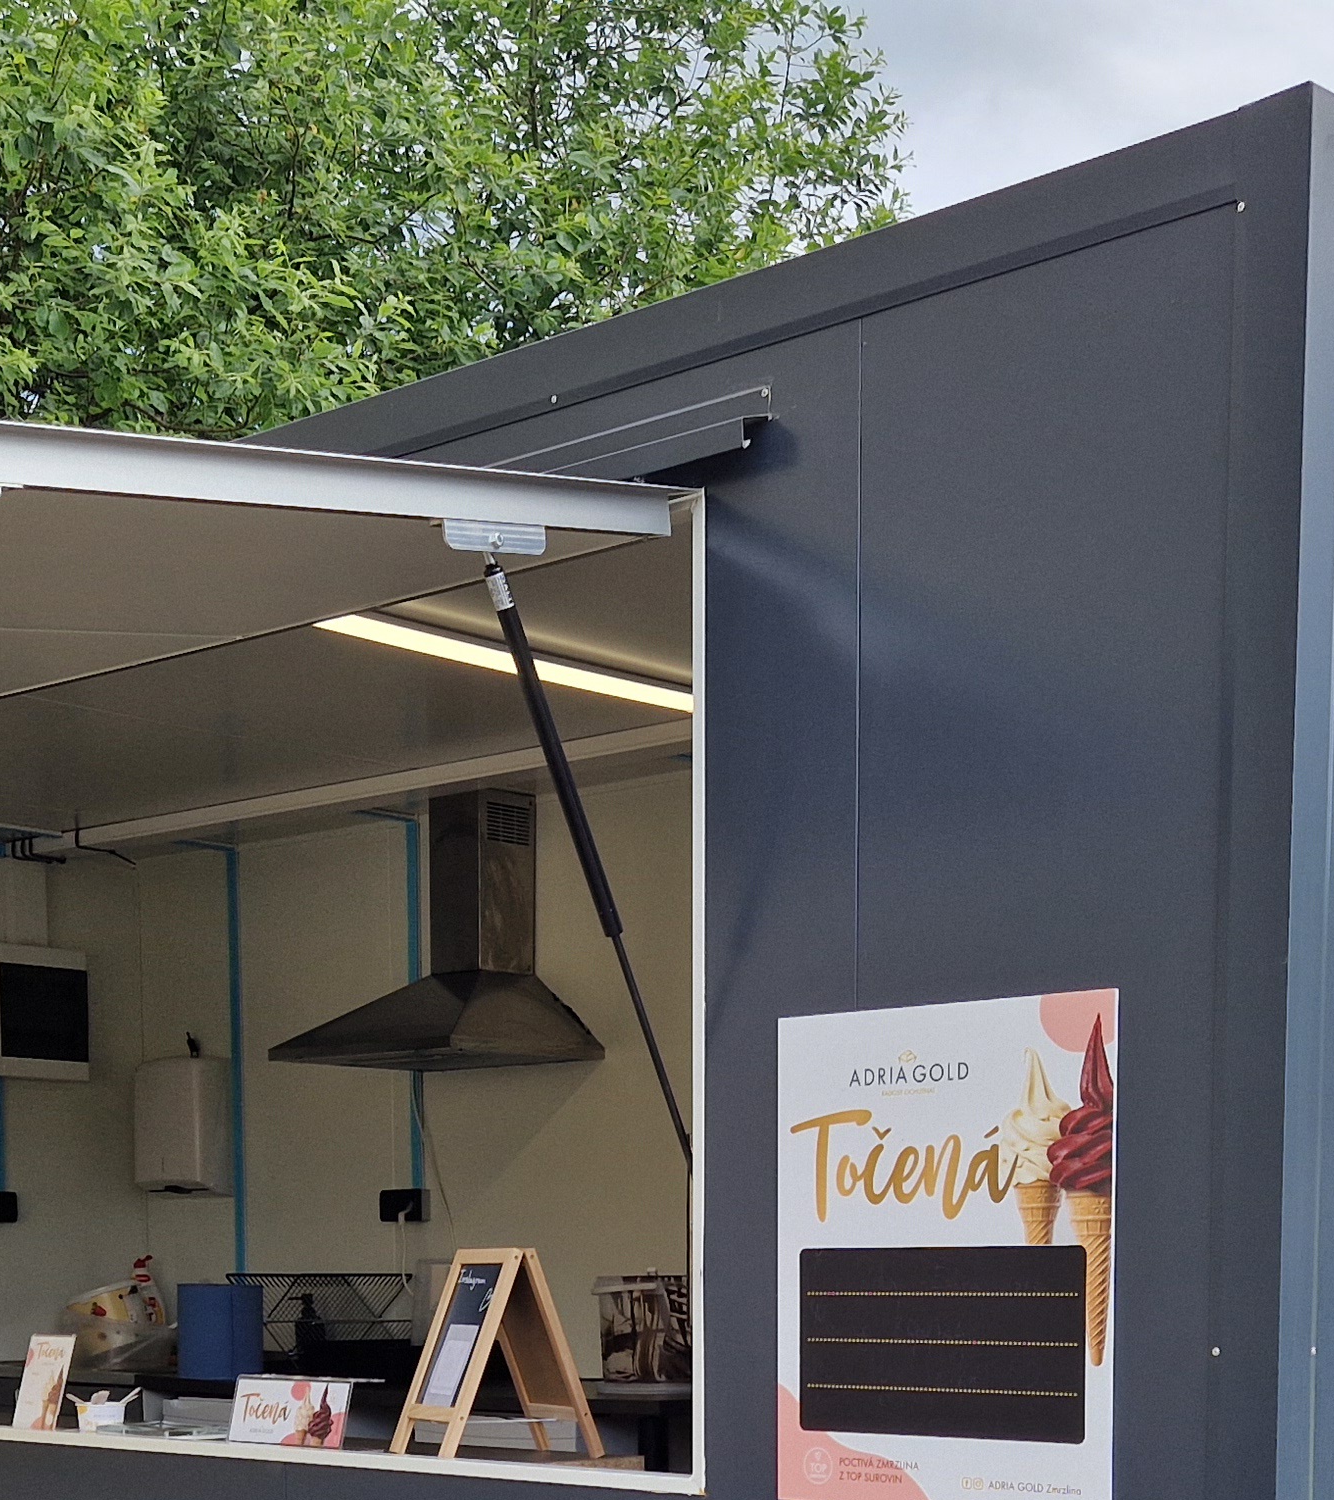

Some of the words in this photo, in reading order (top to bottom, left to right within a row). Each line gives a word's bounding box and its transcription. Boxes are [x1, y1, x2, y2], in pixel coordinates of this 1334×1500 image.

[849, 1066, 908, 1087] ADRIA
[912, 1062, 969, 1083] GOLD
[790, 1109, 1018, 1223] Točená
[810, 1462, 828, 1473] TOP
[839, 1457, 874, 1468] POCTIVÁ
[876, 1459, 919, 1471] ZMRZLINA
[846, 1472, 862, 1482] TOP
[865, 1474, 903, 1484] SUROVIN
[988, 1481, 1015, 1490] ADRIA
[1017, 1482, 1044, 1493] GOLD
